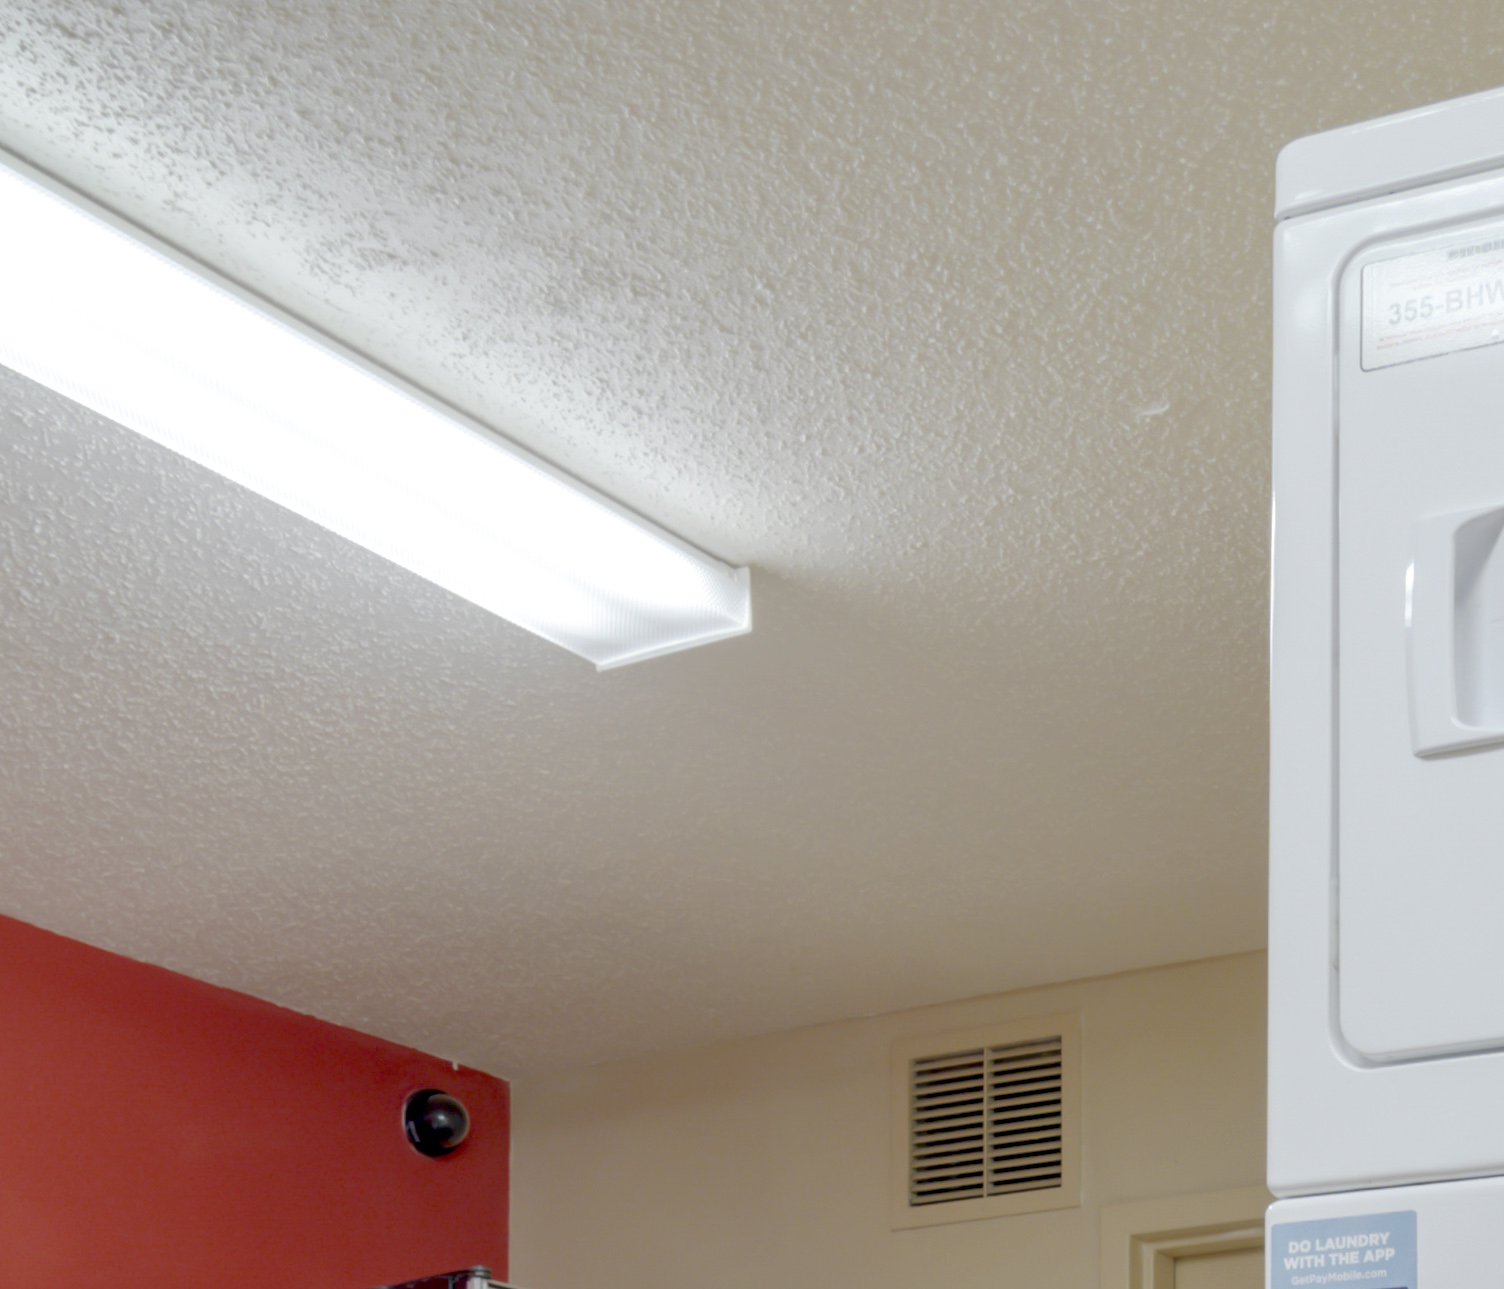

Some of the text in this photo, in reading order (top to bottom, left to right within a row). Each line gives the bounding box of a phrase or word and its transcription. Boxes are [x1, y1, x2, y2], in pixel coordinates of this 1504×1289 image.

[1288, 1232, 1390, 1254] DO LAUNDRY
[1283, 1248, 1395, 1270] WITH THE APP
[1291, 1269, 1387, 1286] GetPayMobile.com
